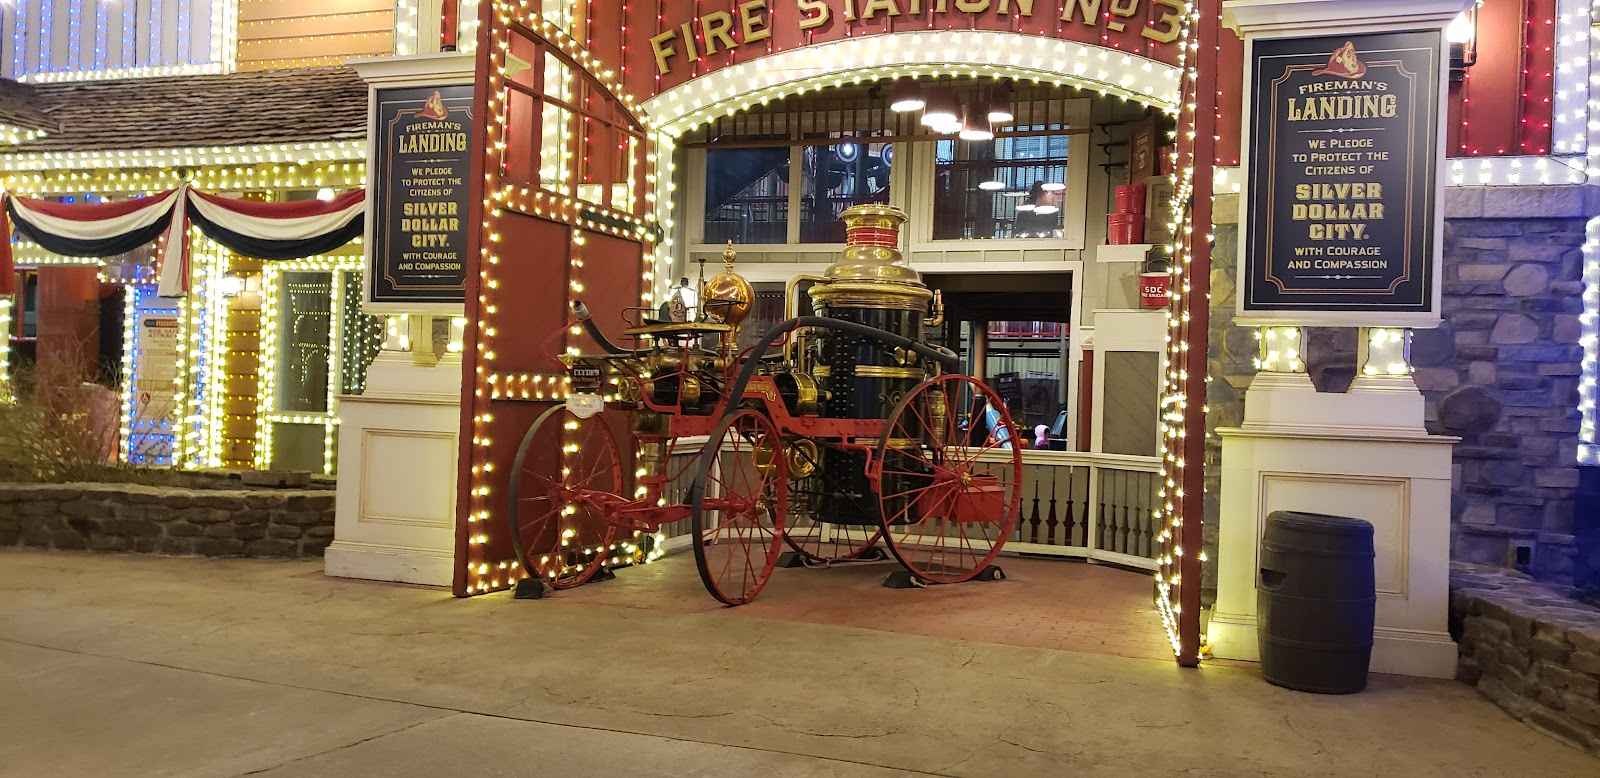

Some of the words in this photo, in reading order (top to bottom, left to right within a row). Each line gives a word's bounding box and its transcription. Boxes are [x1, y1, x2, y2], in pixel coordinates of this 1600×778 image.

[649, 0, 772, 75] FIRE
[1141, 0, 1184, 43] 3
[1299, 81, 1388, 94] FIREMAN'S
[1287, 94, 1398, 121] LANDING
[406, 121, 461, 132] FIREMAN'S
[399, 133, 466, 153] LANDING
[1309, 139, 1326, 149] WE
[1330, 139, 1373, 148] PLEDGE
[1293, 154, 1307, 162] TO
[1311, 152, 1361, 162] PROTECT
[1367, 152, 1389, 161] THE
[425, 167, 452, 175] PLEDGE
[1305, 166, 1355, 175] CITIZENS
[1359, 165, 1374, 174] OF
[413, 178, 445, 186] PROTECT
[448, 177, 461, 185] THE
[409, 189, 441, 197] CITIZENS
[443, 188, 452, 196] OF
[1296, 183, 1381, 200] SILVER
[403, 202, 457, 215] SILVER
[1292, 203, 1384, 220] DOLLAR
[402, 218, 459, 231] DOLLAR
[1295, 247, 1323, 256] WITH
[1327, 246, 1381, 255] COURAGE
[415, 262, 460, 270] COMPASSION
[1288, 260, 1311, 269] AND
[1314, 259, 1387, 269] COMPASSION
